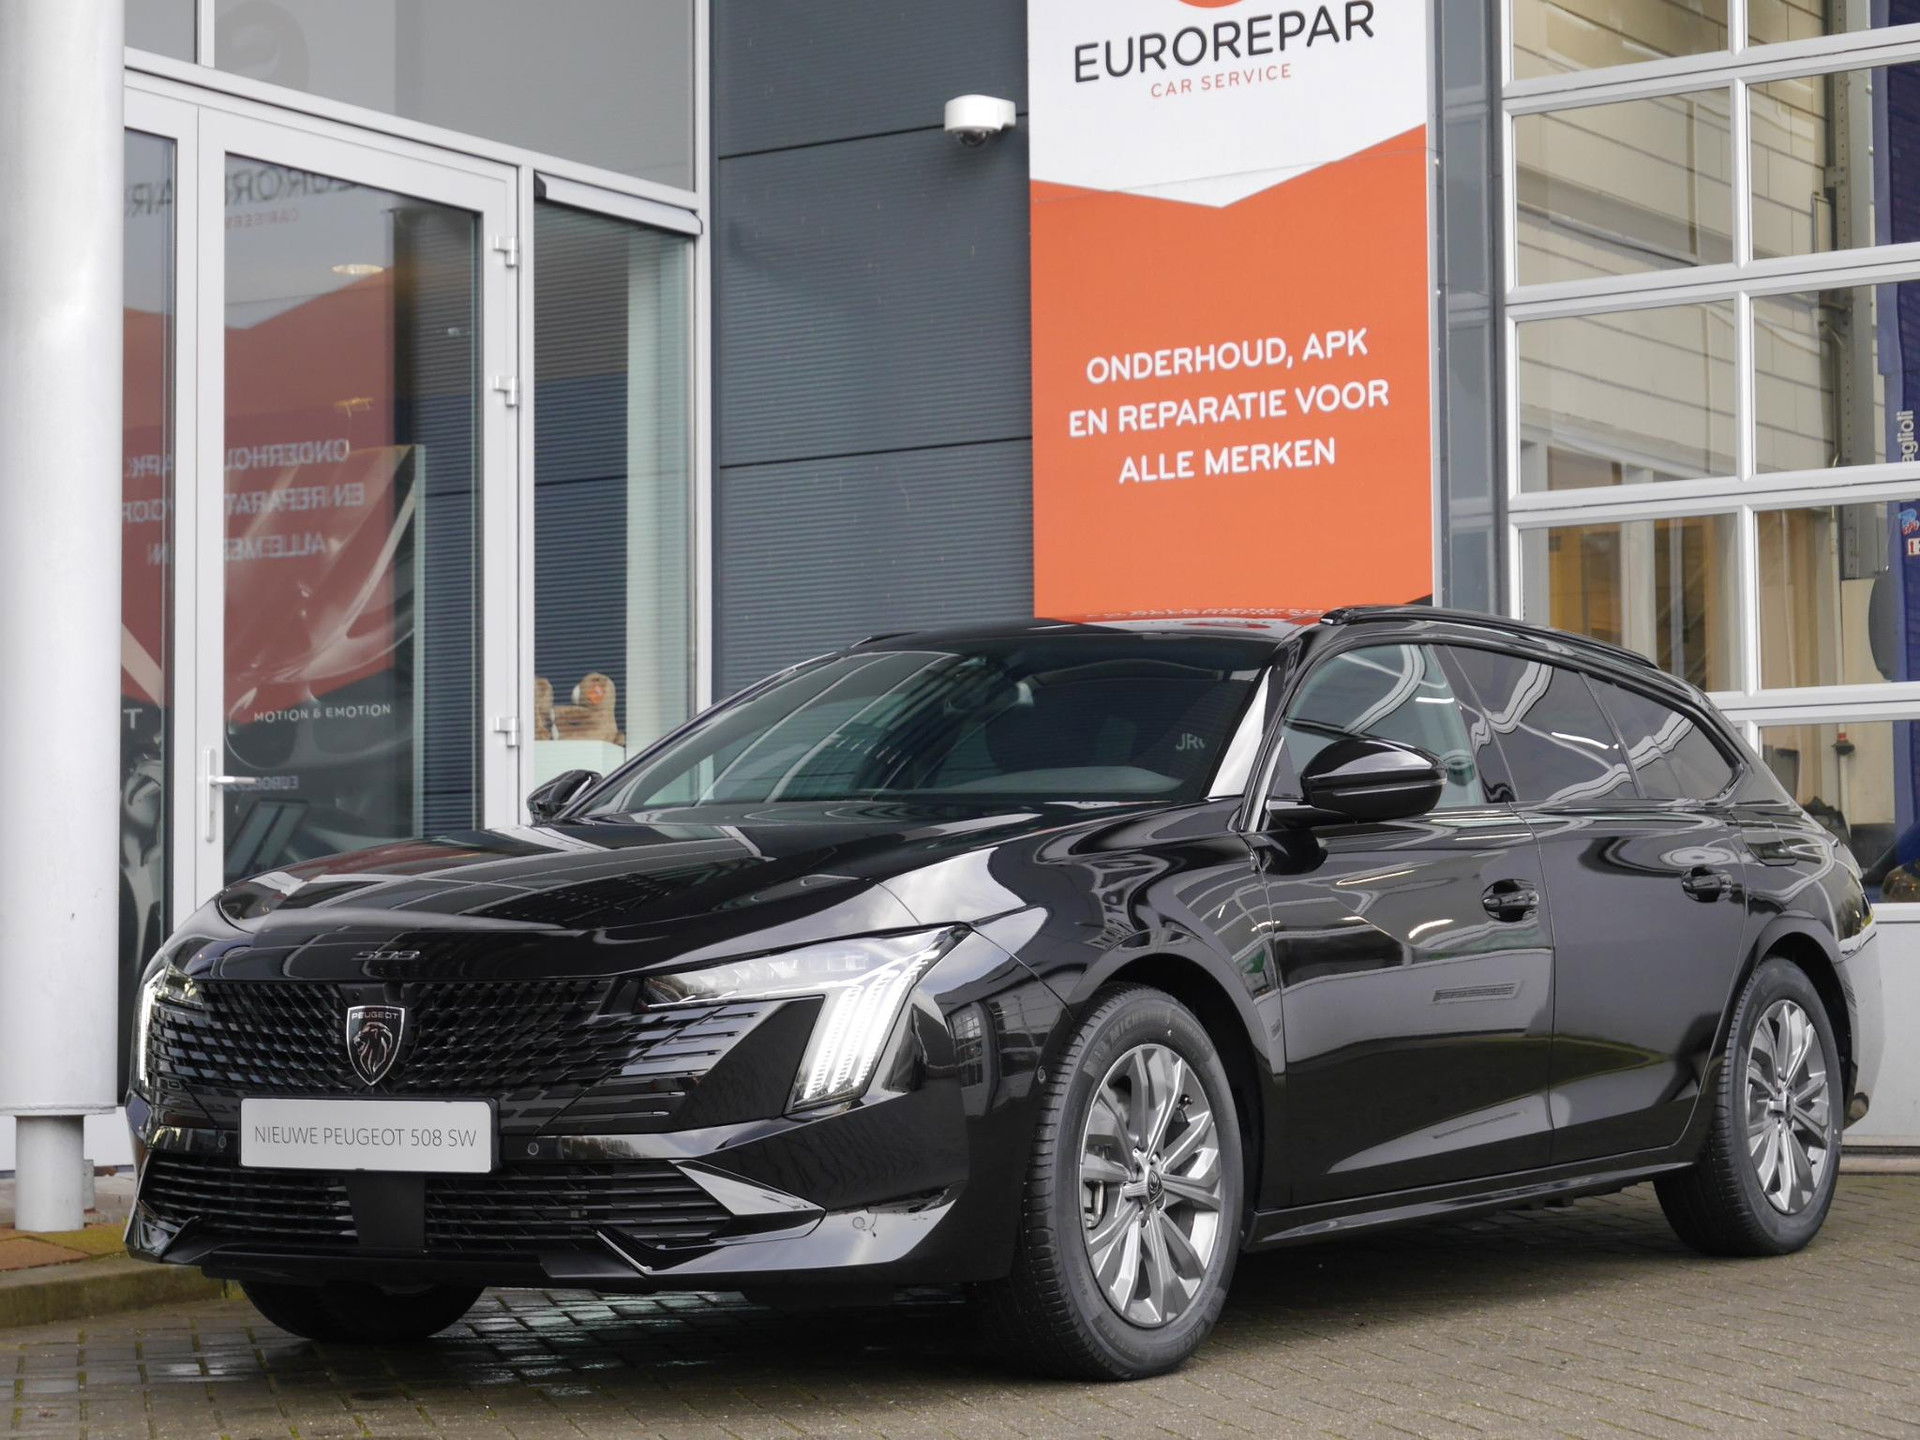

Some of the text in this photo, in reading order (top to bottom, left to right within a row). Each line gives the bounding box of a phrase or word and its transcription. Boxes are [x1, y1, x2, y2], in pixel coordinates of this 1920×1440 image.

[1075, 0, 1375, 83] EUROREPAR
[1150, 63, 1292, 98] CAR SERVICE
[1086, 328, 1368, 384] ONDERHOUD, APK
[1069, 379, 1389, 437] EN REPARATIE VOOR
[1118, 437, 1336, 484] ALLE MERKEN
[254, 709, 309, 723] MOTION
[325, 703, 391, 718] EMOTION
[351, 1011, 399, 1020] PEUGEOT
[254, 1126, 477, 1147] NIEUWE PEUGEOT 508 SW
